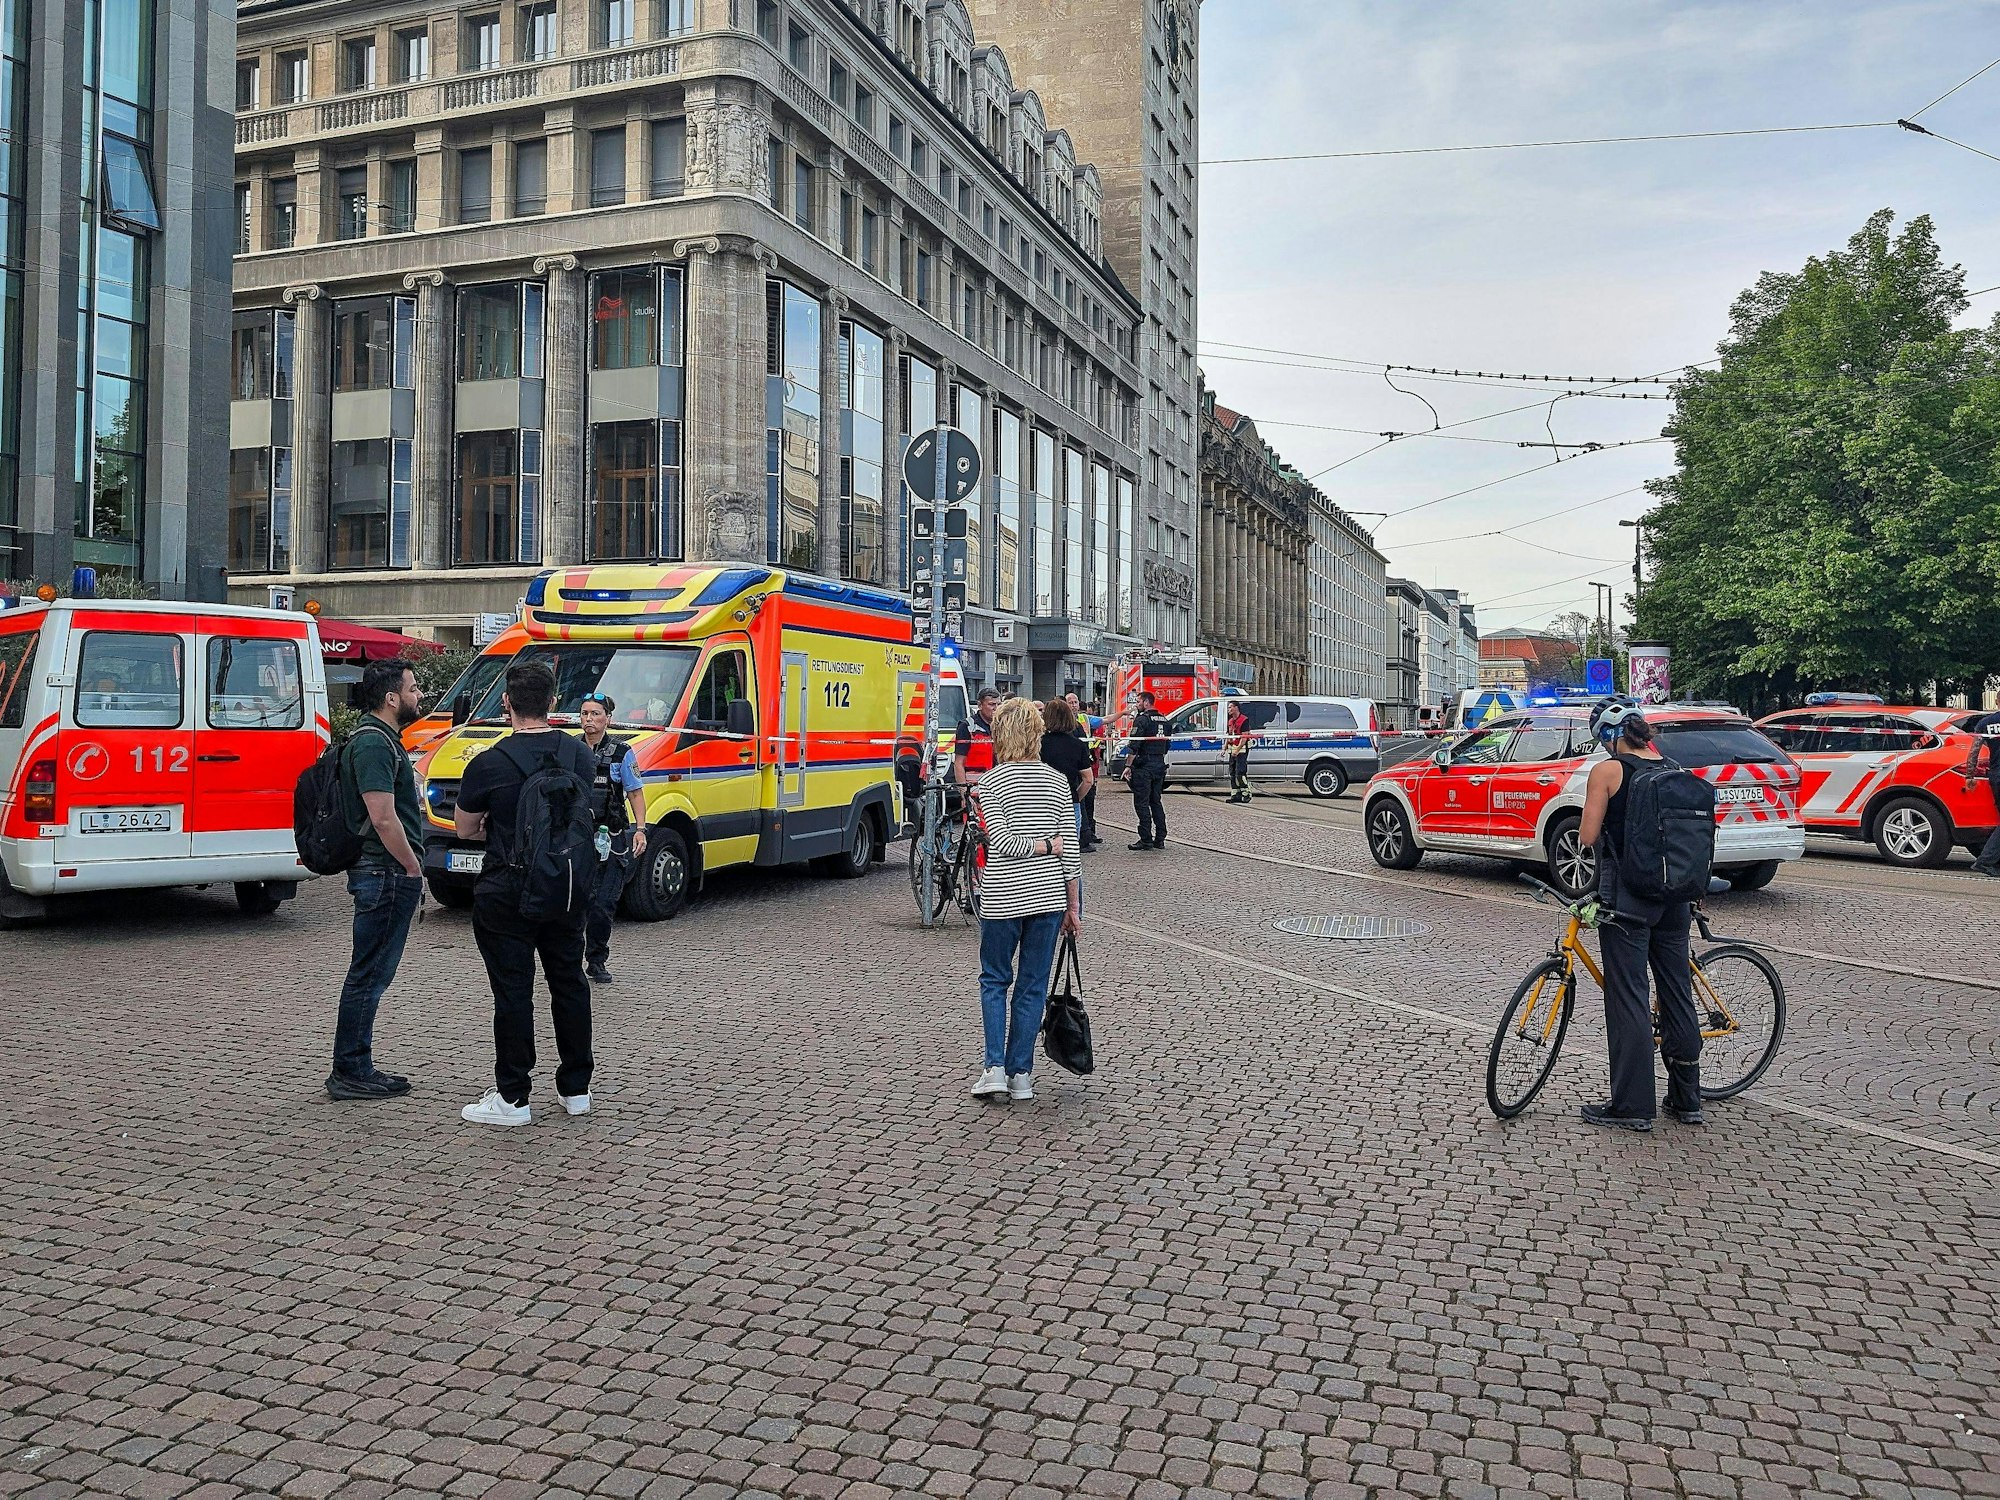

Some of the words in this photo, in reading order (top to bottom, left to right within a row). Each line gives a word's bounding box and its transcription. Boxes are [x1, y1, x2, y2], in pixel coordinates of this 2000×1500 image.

[634, 306, 655, 316] studio
[894, 653, 911, 666] FALCK
[811, 659, 865, 675] RETTUNGSDIENST
[1590, 683, 1611, 693] TAXI
[824, 681, 850, 708] 112
[1167, 689, 1184, 700] 112
[1251, 736, 1285, 747] OLIZEI
[1581, 743, 1594, 754] 112
[130, 746, 189, 772] 112
[1504, 792, 1540, 801] FEUERWEHR
[1504, 801, 1526, 809] LEIPZIG
[89, 815, 98, 828] L
[118, 813, 163, 827] 2642
